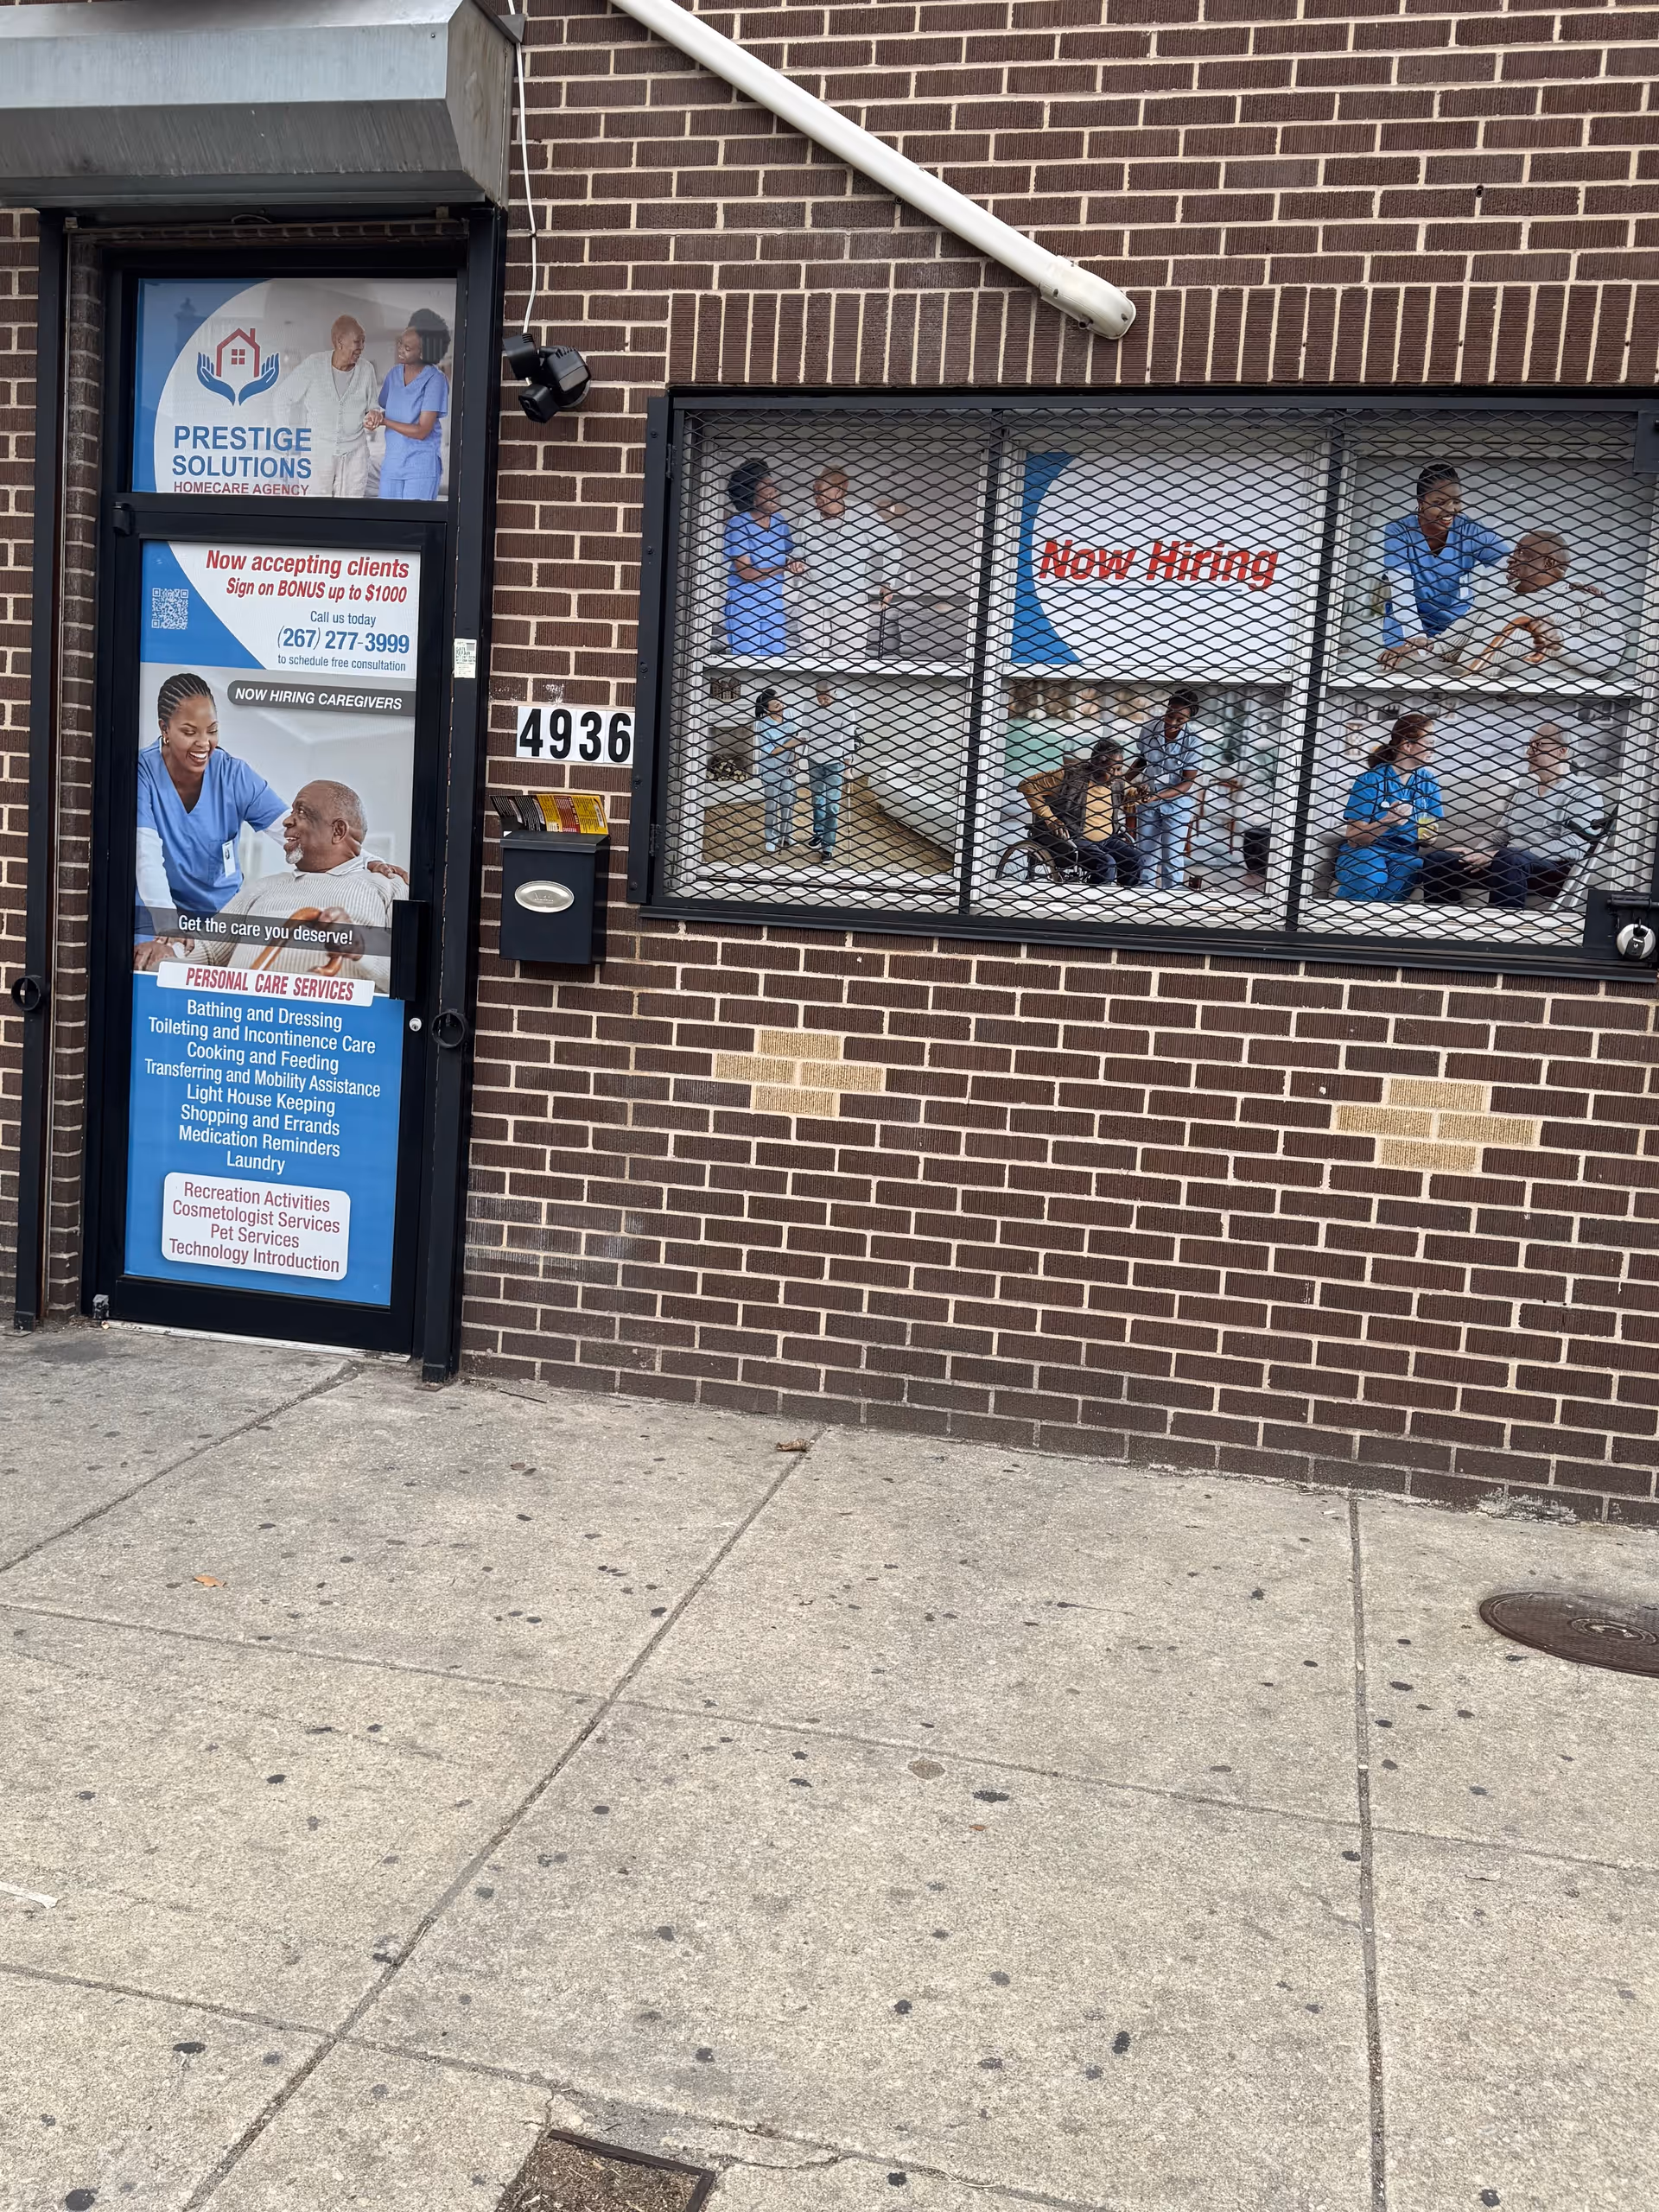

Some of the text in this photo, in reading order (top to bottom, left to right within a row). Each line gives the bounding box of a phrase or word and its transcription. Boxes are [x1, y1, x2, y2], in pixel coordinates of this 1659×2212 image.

[175, 426, 311, 451] PRESTIGE
[173, 454, 311, 479] SOLUTIONS
[174, 481, 309, 495] HOMECARE AGENCY
[207, 550, 409, 579] Now accepting clients
[1039, 539, 1278, 592] Now Hiring
[226, 578, 407, 603] Sign on BONUS up to $1000
[310, 611, 376, 627] Call us today
[277, 626, 410, 653] (267) 277-3999
[277, 655, 405, 671] to schedule free consultation
[235, 688, 403, 709] NOW HIRING CAREGIVERS
[520, 709, 632, 762] 4936
[179, 915, 353, 944] Get the care you deserve!
[186, 968, 354, 1001] PERSONAL CARE SERVICES
[188, 999, 342, 1032] Bathing and Dressing
[149, 1016, 376, 1053] Toileting and Incontinence Care
[187, 1042, 339, 1075] Cooking and Feeding
[145, 1058, 380, 1097] Transferring and Mobility Assistance
[187, 1084, 335, 1116] Light House Keeping
[181, 1104, 340, 1135] Shopping and Errands
[179, 1125, 340, 1157] Medication Reminders
[226, 1151, 285, 1175] Laundry
[184, 1181, 330, 1212] Recreation Activities
[173, 1199, 340, 1233] Cosmetologist Services
[211, 1224, 299, 1248] Pet Services
[169, 1238, 339, 1273] Technology Introduction
